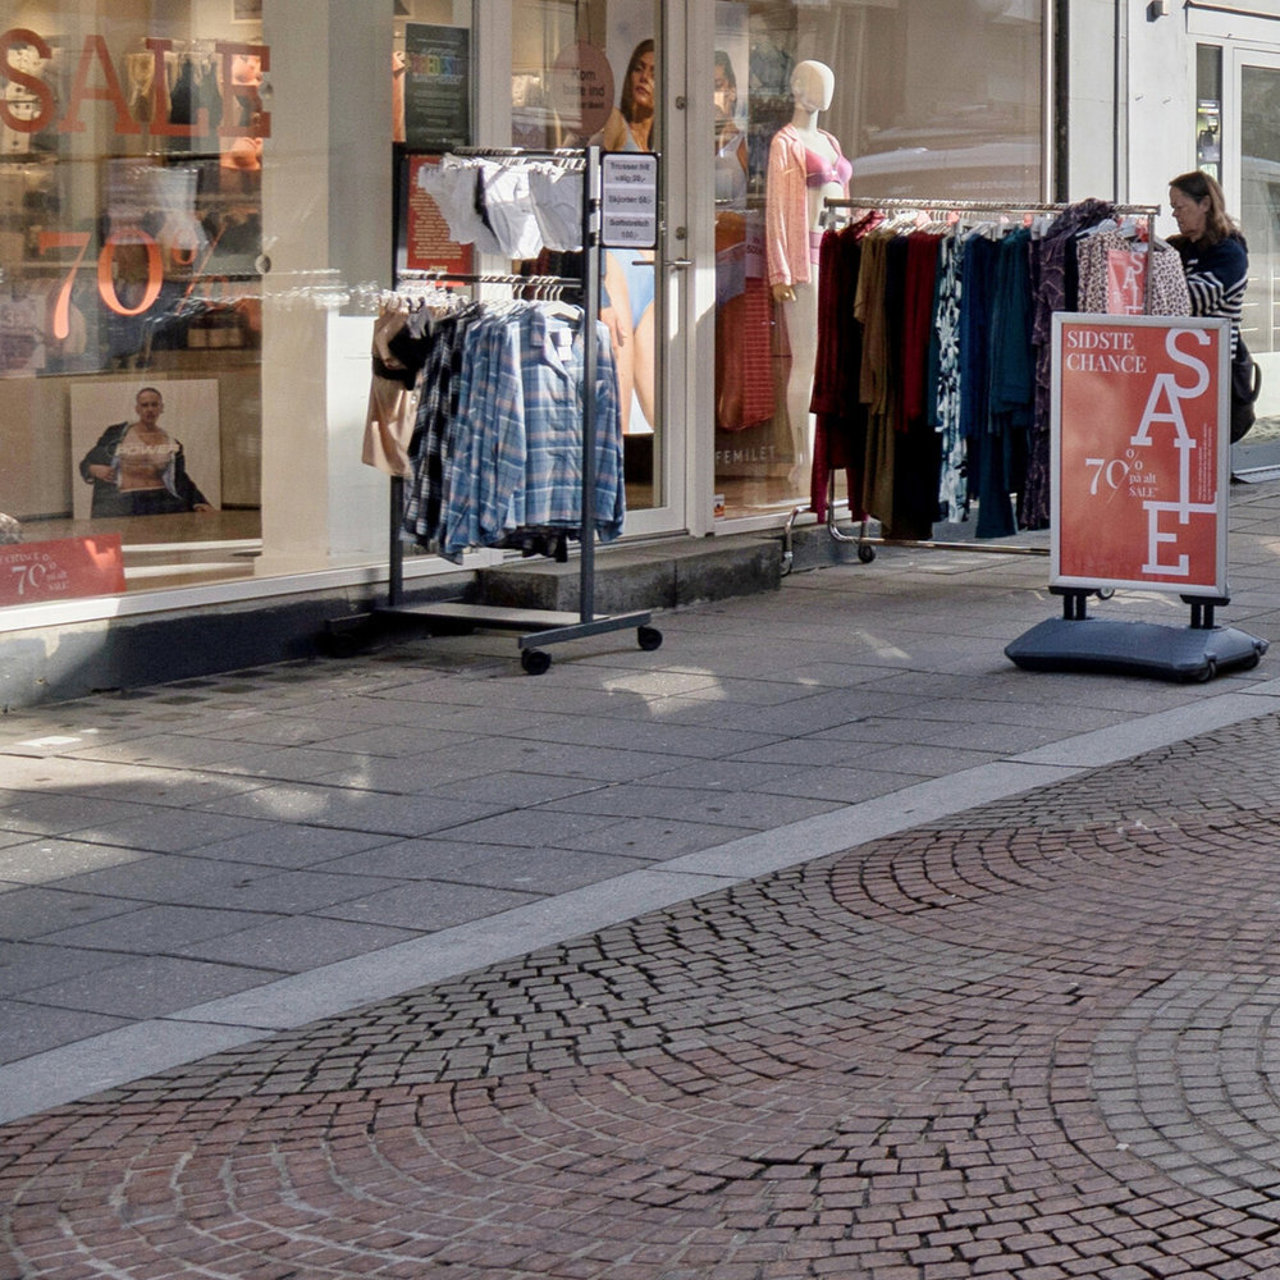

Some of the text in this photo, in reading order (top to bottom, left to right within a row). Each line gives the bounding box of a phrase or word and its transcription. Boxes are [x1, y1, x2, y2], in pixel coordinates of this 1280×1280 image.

[0, 28, 271, 138] SALE
[1066, 330, 1134, 350] SIDSTE
[1066, 353, 1147, 374] CHANCE
[1085, 448, 1143, 505] 70%
[1130, 328, 1218, 576] SALE
